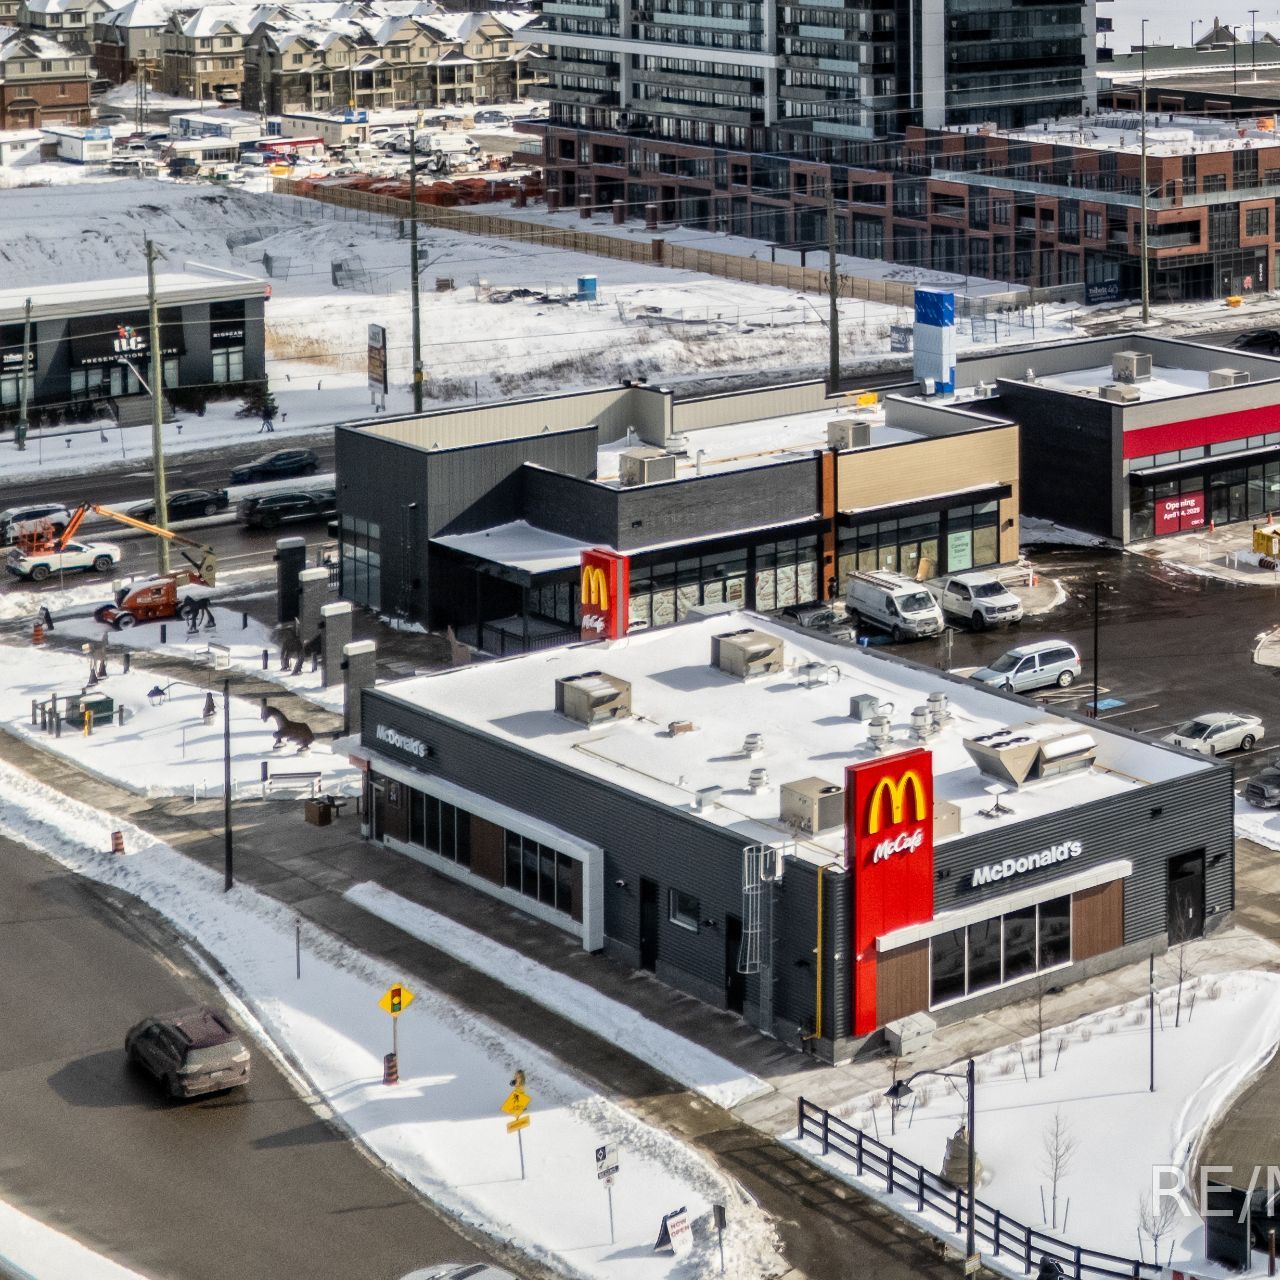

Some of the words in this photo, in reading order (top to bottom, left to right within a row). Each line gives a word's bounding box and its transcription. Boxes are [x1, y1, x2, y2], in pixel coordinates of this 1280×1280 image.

[81, 353, 143, 365] PRESENTATION
[146, 348, 178, 357] CTRE
[1165, 499, 1195, 510] Opening
[1163, 511, 1176, 520] April
[376, 724, 426, 758] McDonald's
[972, 841, 1082, 887] McDonald's
[670, 1218, 688, 1229] NOW
[671, 1224, 690, 1238] OPEN
